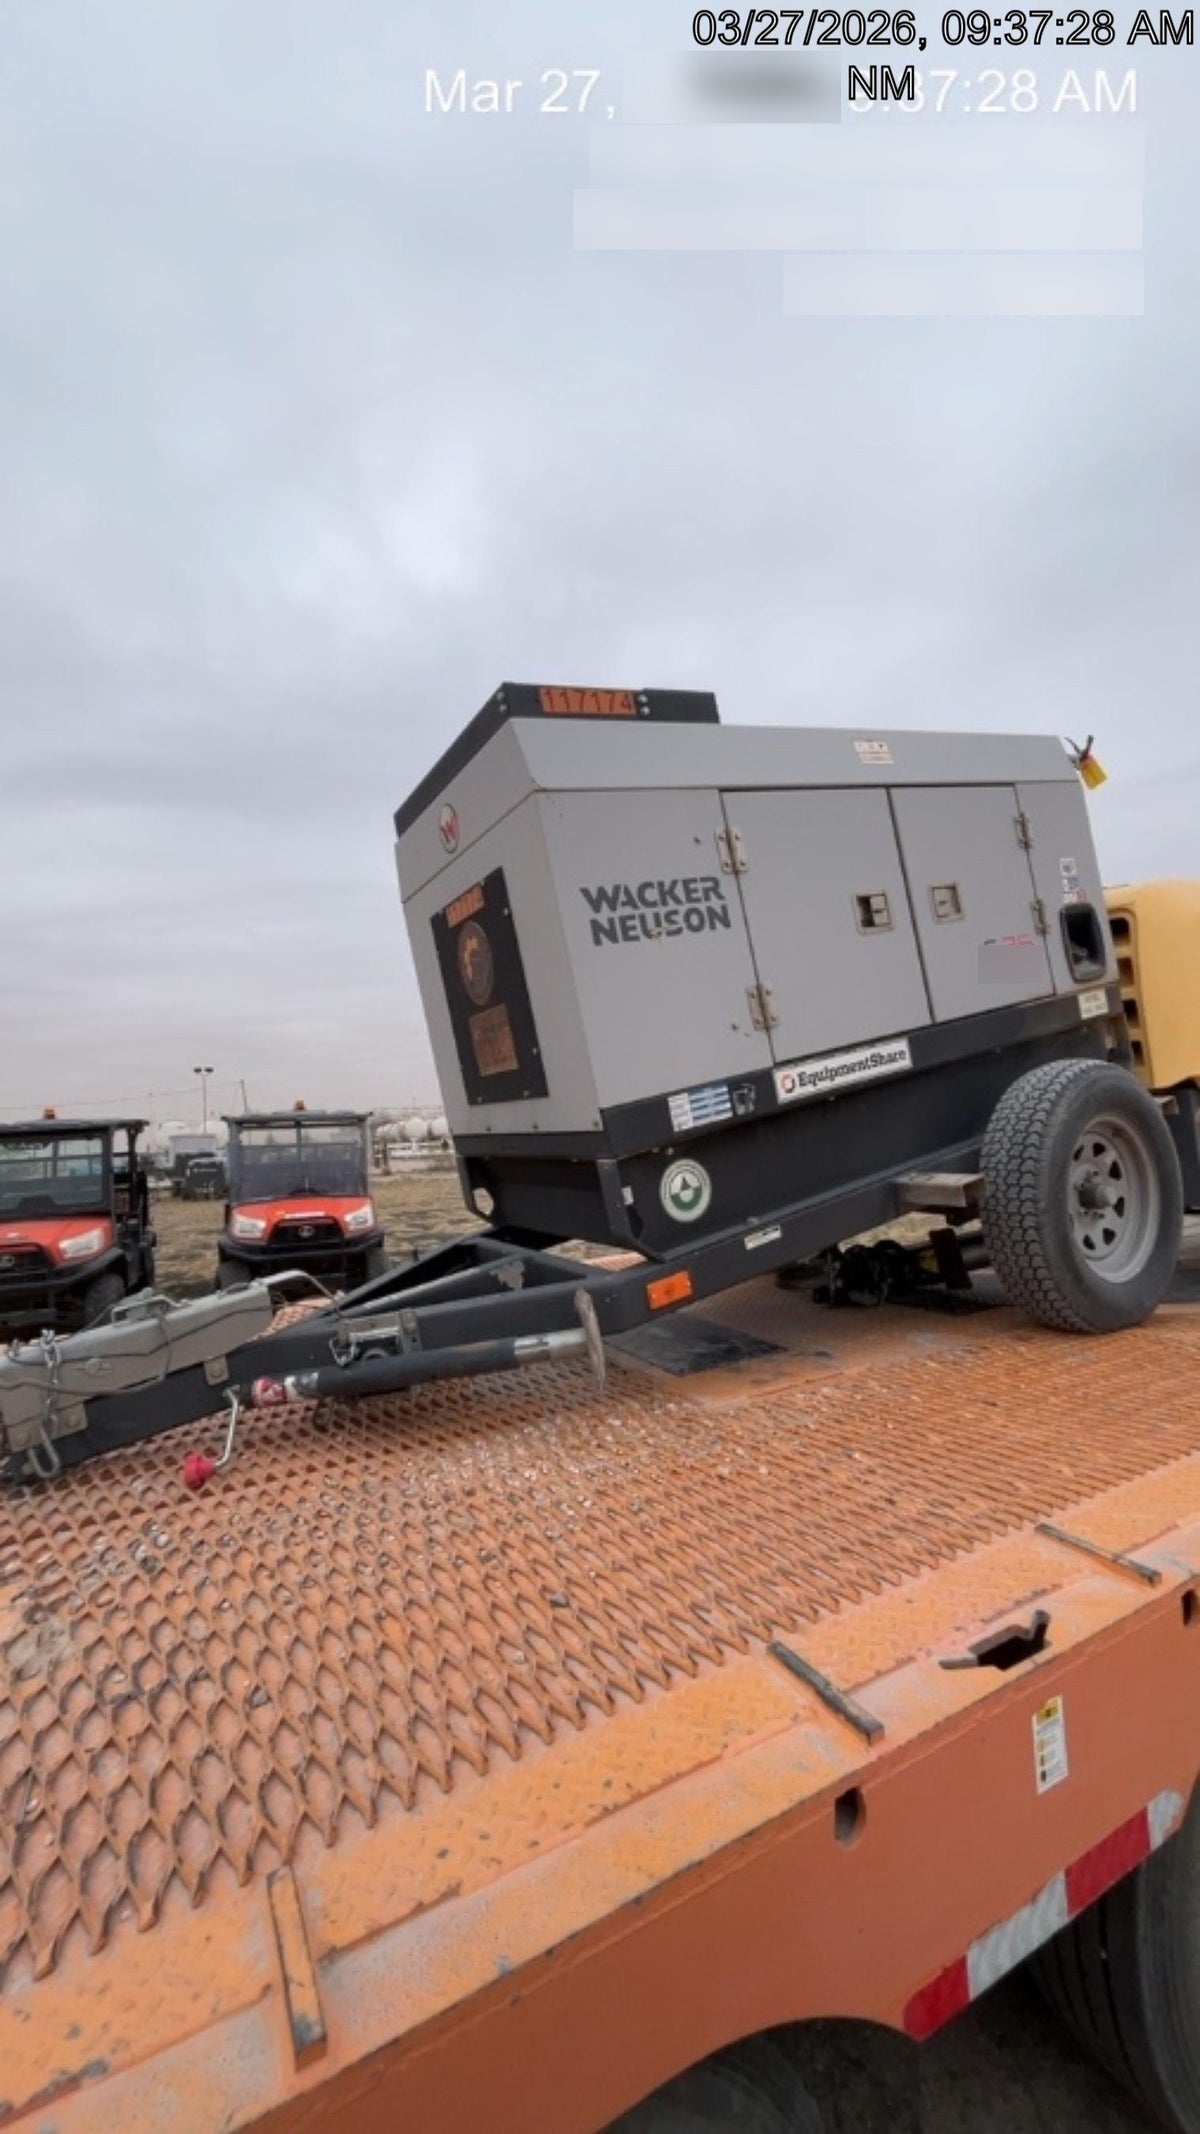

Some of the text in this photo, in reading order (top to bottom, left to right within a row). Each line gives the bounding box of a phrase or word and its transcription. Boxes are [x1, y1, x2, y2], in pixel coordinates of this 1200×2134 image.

[543, 688, 632, 713] 117174
[579, 876, 726, 914] WACKER
[590, 904, 731, 946] NEUSON
[798, 1049, 907, 1087] EquipmentShare
